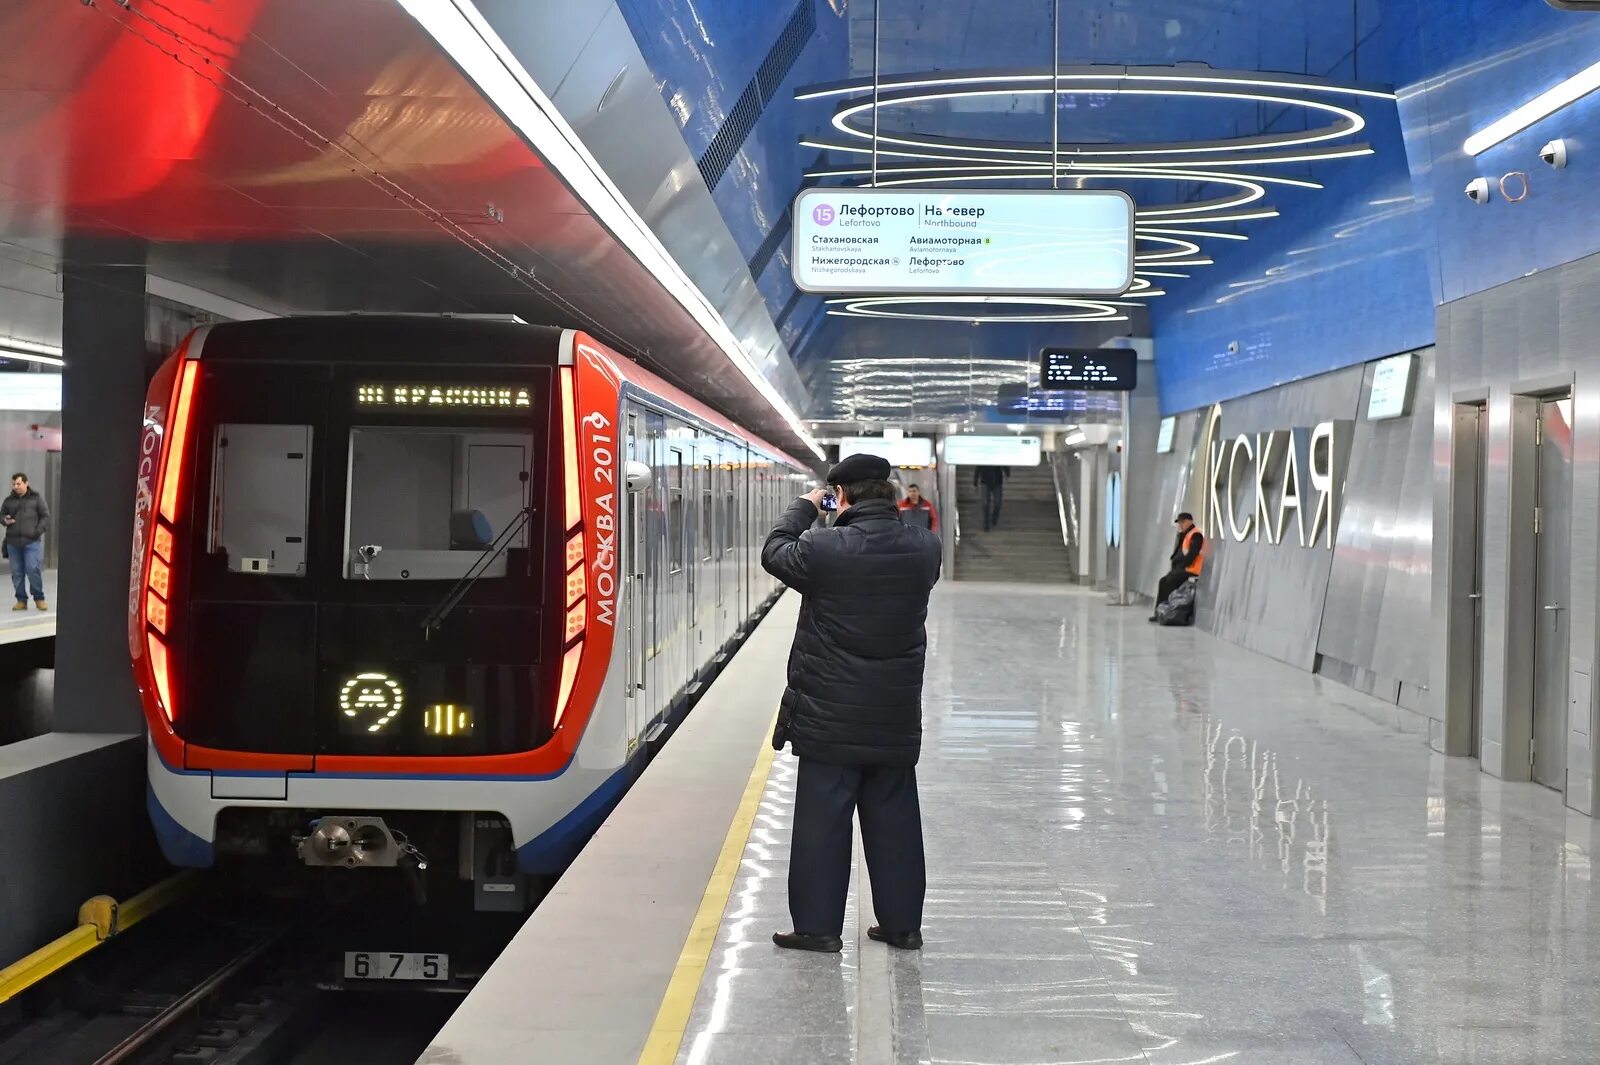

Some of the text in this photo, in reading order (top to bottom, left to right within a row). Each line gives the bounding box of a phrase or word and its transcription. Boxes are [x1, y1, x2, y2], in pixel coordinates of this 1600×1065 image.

[815, 203, 915, 221] 15 Лефортово
[925, 204, 943, 216] На
[839, 218, 881, 227] Lefortovo
[924, 219, 977, 228] Northbound
[812, 234, 879, 244] Стахановская
[909, 236, 982, 246] Авиамоторная
[811, 256, 890, 267] Нижегородская
[590, 411, 614, 626] МОСКВА 2019
